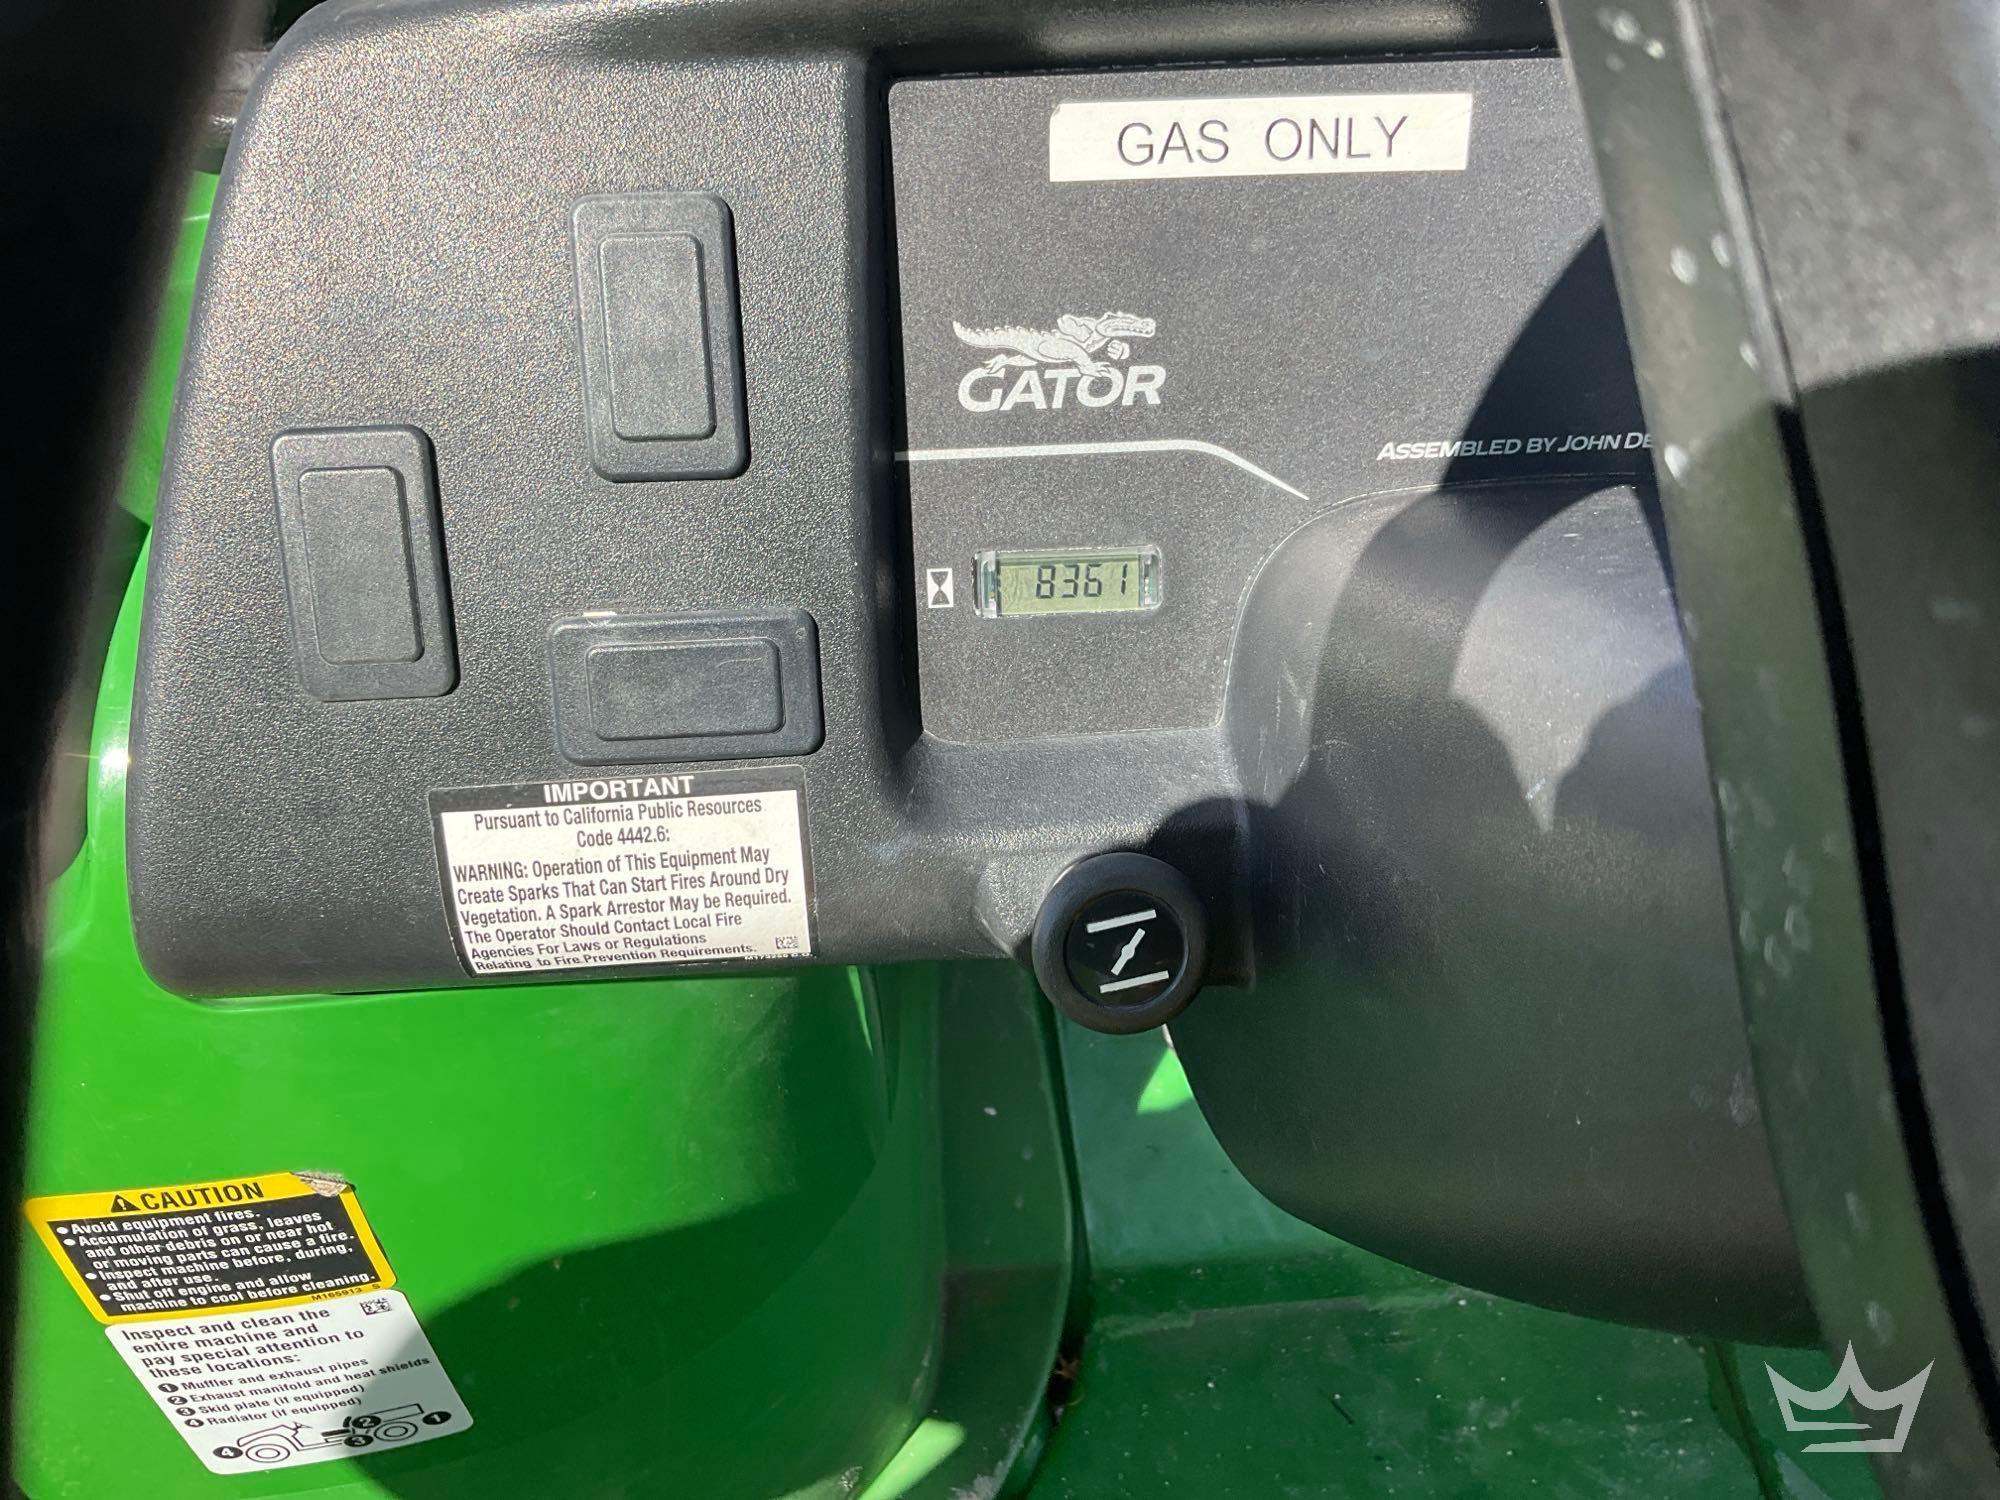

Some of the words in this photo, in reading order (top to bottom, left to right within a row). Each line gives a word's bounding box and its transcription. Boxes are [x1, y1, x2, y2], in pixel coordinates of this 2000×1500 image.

[1117, 119, 1229, 166] GAS
[1264, 115, 1408, 161] ONLY
[957, 364, 1166, 412] GATOR
[1376, 439, 1521, 461] ASSEMBLED
[1526, 437, 1558, 453] BY
[1558, 433, 1620, 452] JOHN
[544, 776, 694, 803] IMPORTANT
[474, 810, 542, 830] Pursuant
[548, 811, 559, 826] to
[564, 805, 633, 825] California
[638, 802, 683, 820] Public
[687, 799, 762, 817] Resources
[577, 830, 613, 848] Code
[617, 825, 670, 844] 4442.6:
[453, 861, 528, 882] WARNING:
[532, 858, 602, 880] Operation
[608, 855, 621, 872] of
[624, 853, 656, 871] This
[660, 849, 737, 870] Equipment
[741, 846, 770, 865] May
[458, 888, 504, 905] Create
[508, 883, 559, 904] Sparks
[562, 881, 595, 898] That
[600, 879, 627, 895] Can
[632, 874, 667, 893] Start
[671, 873, 705, 890] Fires
[710, 868, 760, 888] Around
[765, 868, 789, 886] Dry
[460, 907, 542, 928] Vegetation.
[546, 905, 556, 920] A
[559, 902, 602, 922] Spark
[607, 899, 665, 916] Arrestor
[670, 896, 698, 913] May
[703, 894, 720, 909] be
[725, 888, 792, 908] Required.
[465, 930, 491, 944] The
[495, 927, 556, 944] Operator
[561, 921, 609, 938] Should
[614, 917, 670, 933] Contact
[674, 913, 711, 930] Local
[716, 912, 742, 927] Fire
[471, 945, 534, 960] Agencies
[537, 943, 559, 955] For
[563, 941, 600, 953] Laws
[605, 940, 619, 950] or
[623, 933, 708, 949] Regulations
[475, 958, 532, 971] Relating
[537, 958, 551, 967] to
[555, 955, 579, 966] Fire
[583, 951, 656, 963] Prevention
[660, 944, 757, 959] Requirements.
[140, 1182, 264, 1210] CAUTION
[72, 1221, 118, 1234] Avoid
[122, 1211, 212, 1233] equipment
[214, 1208, 261, 1221] fires.
[79, 1228, 189, 1247] Accumulation
[192, 1226, 208, 1237] of
[214, 1219, 264, 1237] grass,
[267, 1212, 322, 1228] leaves
[85, 1245, 116, 1258] and
[119, 1243, 165, 1256] other
[165, 1238, 217, 1252] debris
[221, 1238, 241, 1248] on
[245, 1234, 261, 1243] or
[266, 1227, 302, 1240] near
[307, 1221, 334, 1233] hot
[93, 1260, 110, 1270] or
[114, 1255, 173, 1268] moving
[176, 1250, 218, 1263] parts
[222, 1248, 250, 1258] can
[254, 1239, 301, 1254] cause
[306, 1237, 316, 1245] a
[319, 1231, 355, 1244] fire.
[99, 1265, 158, 1281] Inspect
[161, 1260, 229, 1275] machine
[233, 1253, 291, 1268] before,
[295, 1243, 353, 1260] during,
[107, 1280, 137, 1291] and
[142, 1277, 179, 1288] after
[184, 1273, 219, 1284] use.
[112, 1291, 149, 1302] Shut
[154, 1287, 174, 1297] off
[179, 1280, 231, 1296] engine
[235, 1277, 265, 1289] and
[269, 1271, 312, 1285] allow
[120, 1299, 187, 1312] machine
[190, 1296, 207, 1305] to
[211, 1290, 244, 1304] cool
[249, 1282, 298, 1299] before
[302, 1272, 375, 1292] cleaning.
[122, 1325, 195, 1341] Inspect
[198, 1321, 235, 1334] and
[241, 1314, 294, 1329] clean
[300, 1308, 330, 1321] the
[132, 1340, 189, 1353] entire
[194, 1331, 278, 1348] machine
[282, 1323, 318, 1338] and
[142, 1355, 175, 1368] pay
[181, 1346, 251, 1363] special
[256, 1333, 341, 1354] attention
[345, 1330, 365, 1340] to
[149, 1366, 202, 1378] these
[207, 1354, 301, 1373] locations:
[181, 1378, 234, 1390] Muffler
[240, 1374, 265, 1384] and
[269, 1366, 326, 1381] exhaust
[328, 1358, 369, 1372] pipes
[190, 1390, 245, 1402] Exhaust
[249, 1381, 311, 1396] manifold
[315, 1376, 341, 1386] and
[344, 1369, 376, 1382] heat
[379, 1358, 431, 1375] shields
[199, 1404, 231, 1414] Skid
[235, 1400, 271, 1411] plate
[274, 1395, 290, 1406] (if
[293, 1384, 365, 1402] equipped)
[207, 1412, 268, 1425] Radiator
[272, 1407, 288, 1418] (if
[292, 1397, 362, 1415] equipped)
